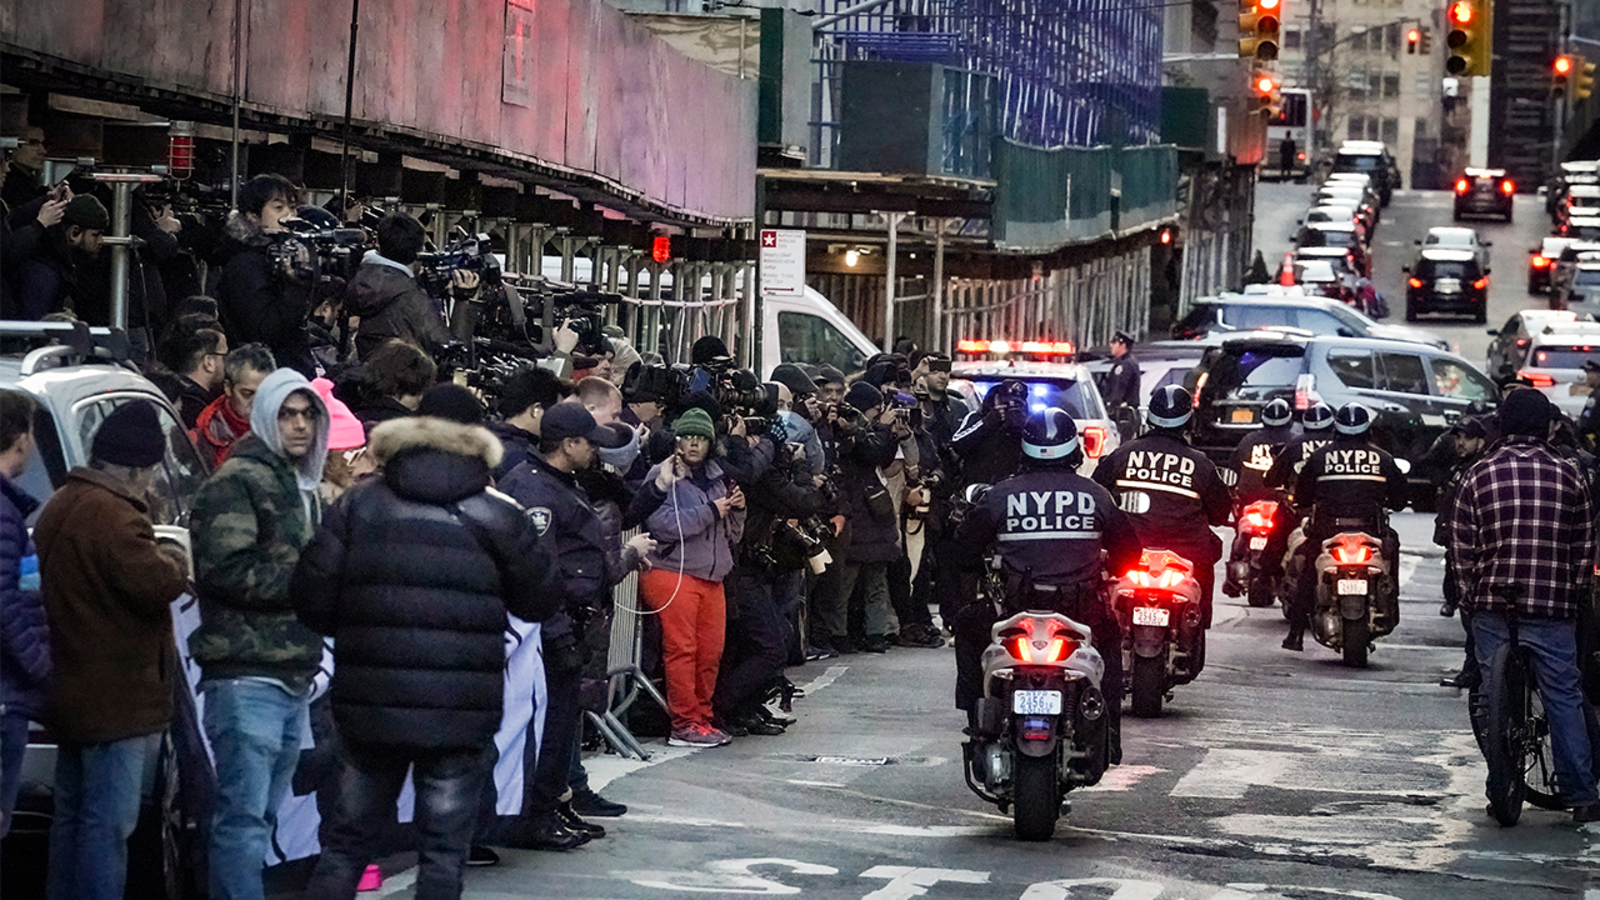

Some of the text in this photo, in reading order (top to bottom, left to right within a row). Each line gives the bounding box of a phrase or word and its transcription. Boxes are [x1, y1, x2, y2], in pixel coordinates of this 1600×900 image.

[1302, 440, 1333, 453] NY
[1127, 450, 1195, 476] NYPD
[1325, 450, 1381, 465] NYPD
[1324, 464, 1381, 474] POLICE
[1125, 467, 1192, 488] POLICE
[1006, 490, 1096, 517] NYPD
[1006, 515, 1096, 531] POLICE
[1020, 696, 1045, 708] 2456
